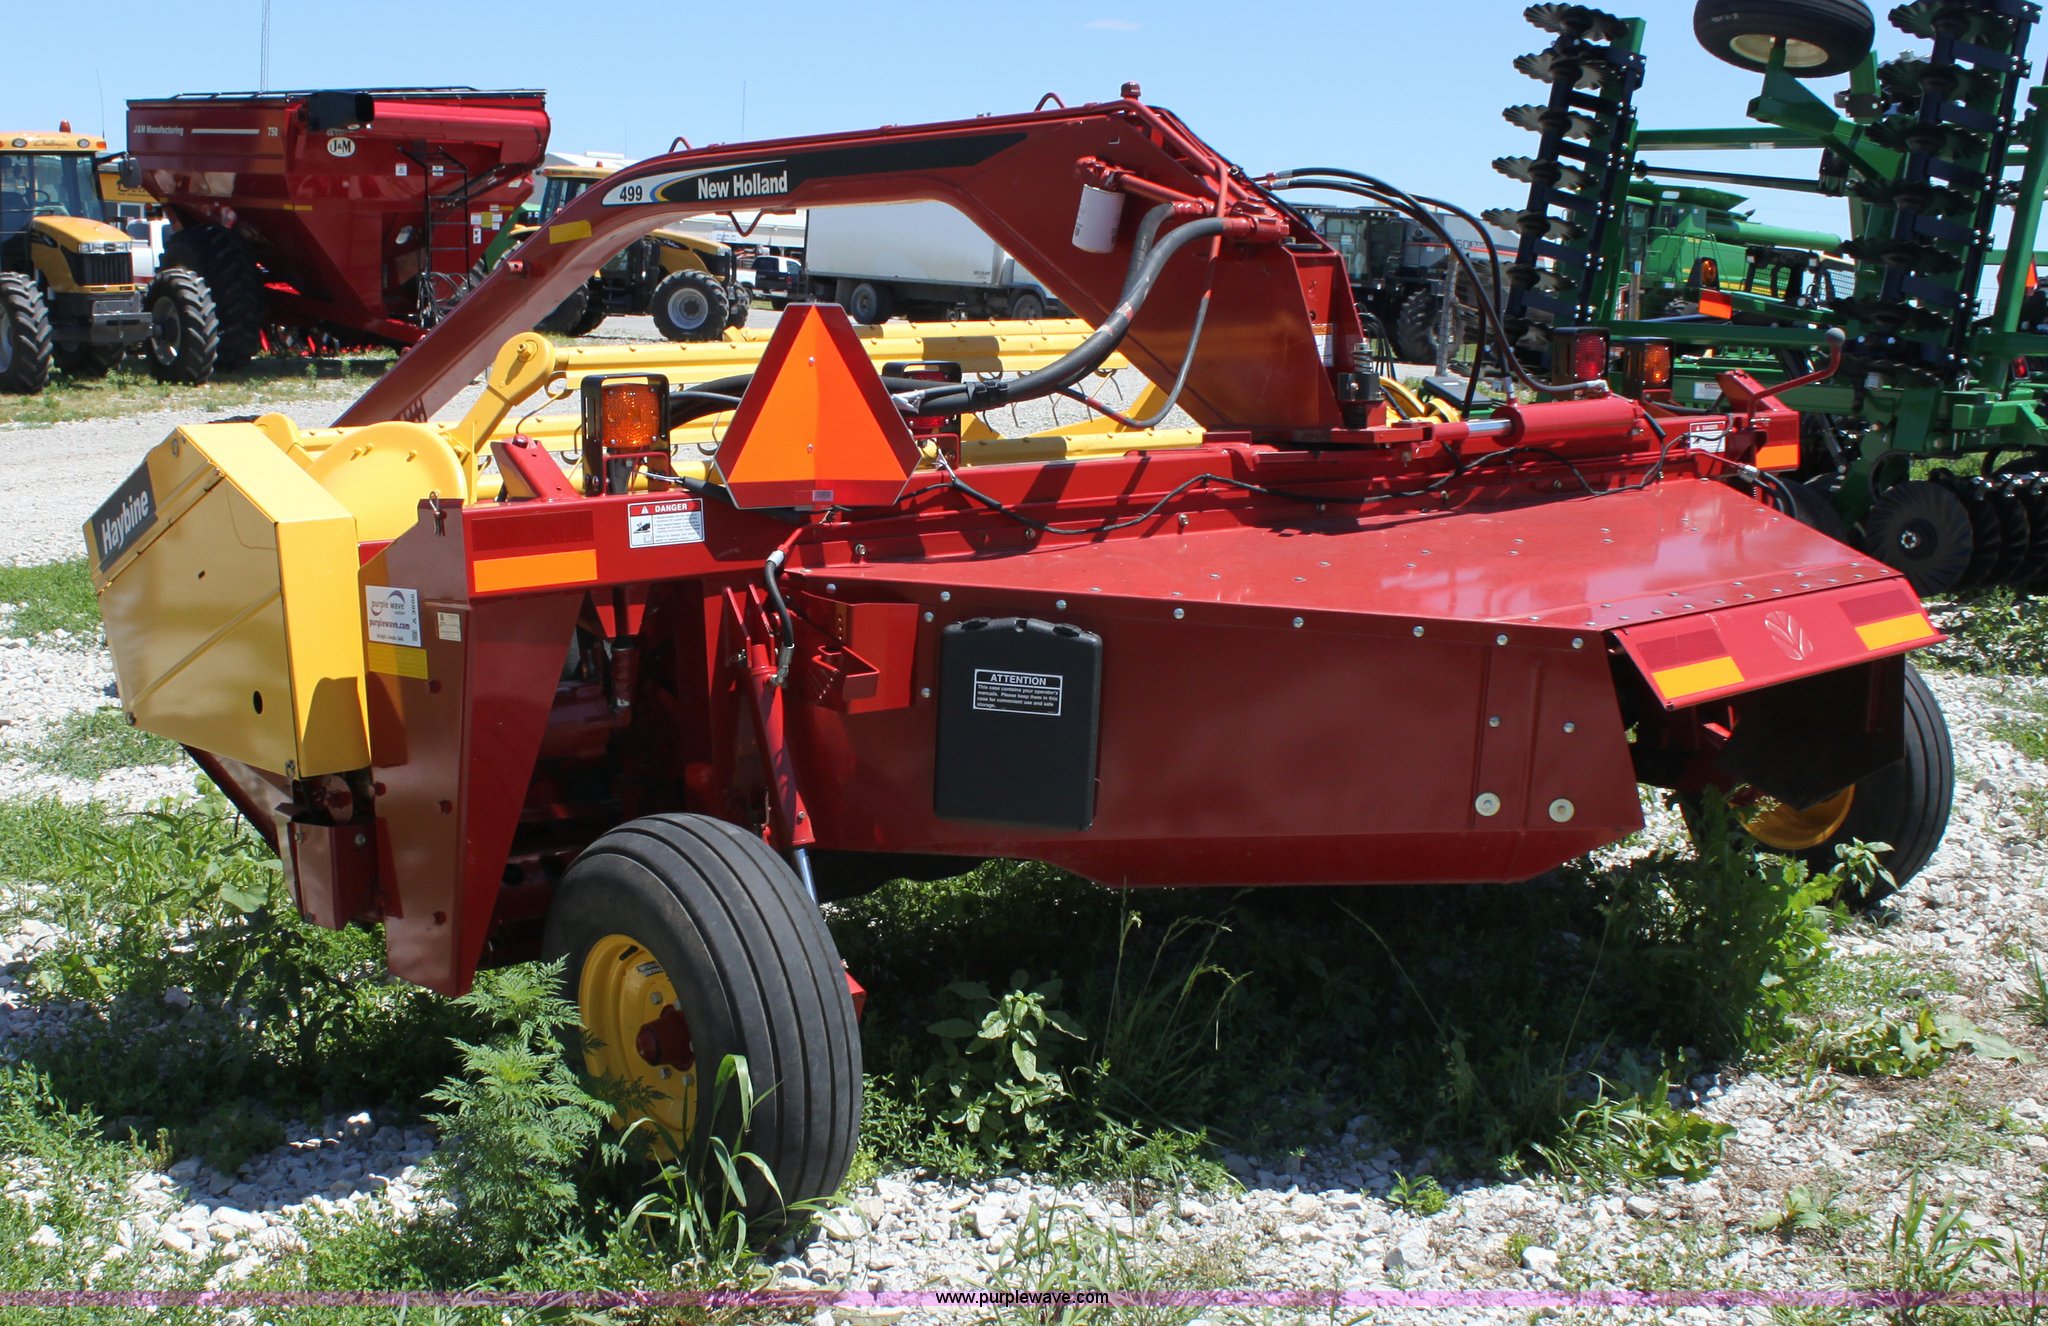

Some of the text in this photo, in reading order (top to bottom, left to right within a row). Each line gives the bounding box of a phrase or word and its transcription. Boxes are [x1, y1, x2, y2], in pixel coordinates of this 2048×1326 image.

[146, 125, 185, 137] Manufacturing
[329, 139, 352, 154] J&M
[619, 170, 788, 202] 499 New Holland
[654, 503, 688, 512] DANGER
[101, 490, 149, 556] Haybine
[371, 599, 405, 611] purple wave
[369, 618, 411, 631] purplewave.com
[990, 674, 1047, 686] ATTENTION
